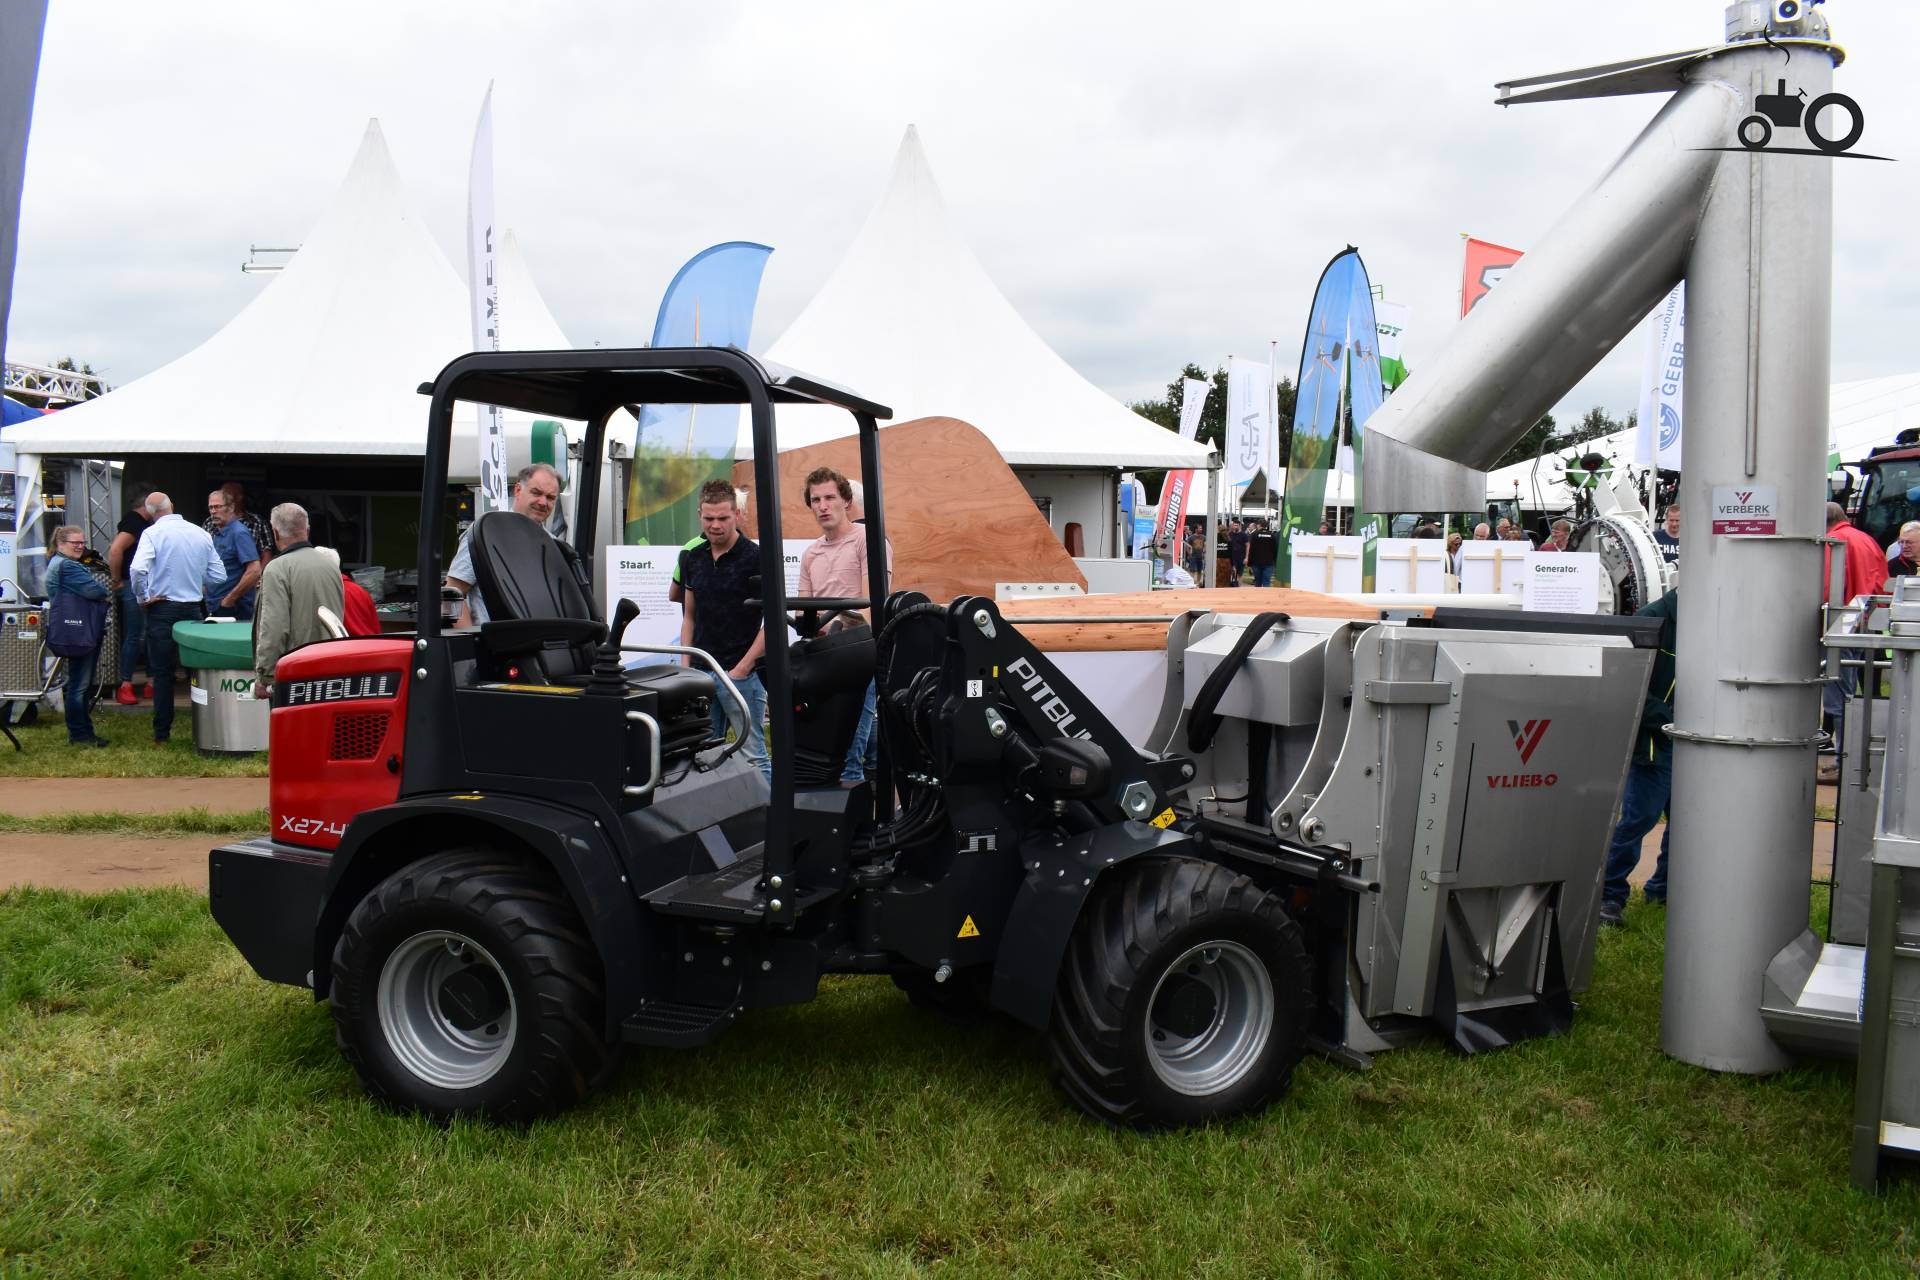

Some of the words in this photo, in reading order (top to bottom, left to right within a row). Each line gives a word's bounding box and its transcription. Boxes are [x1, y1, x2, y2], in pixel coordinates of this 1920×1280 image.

[1240, 412, 1260, 471] GEA
[1719, 505, 1770, 514] VERBERK
[620, 560, 655, 570] Staart.
[1535, 564, 1580, 574] Generator.
[288, 676, 393, 704] PITBULL
[1006, 656, 1092, 740] PITBU
[1436, 740, 1443, 752] 5
[1433, 767, 1439, 779] 4
[1487, 773, 1558, 789] VLIEBO
[1429, 792, 1436, 804] 3
[280, 814, 350, 839] X27-4
[1426, 818, 1434, 830] 2
